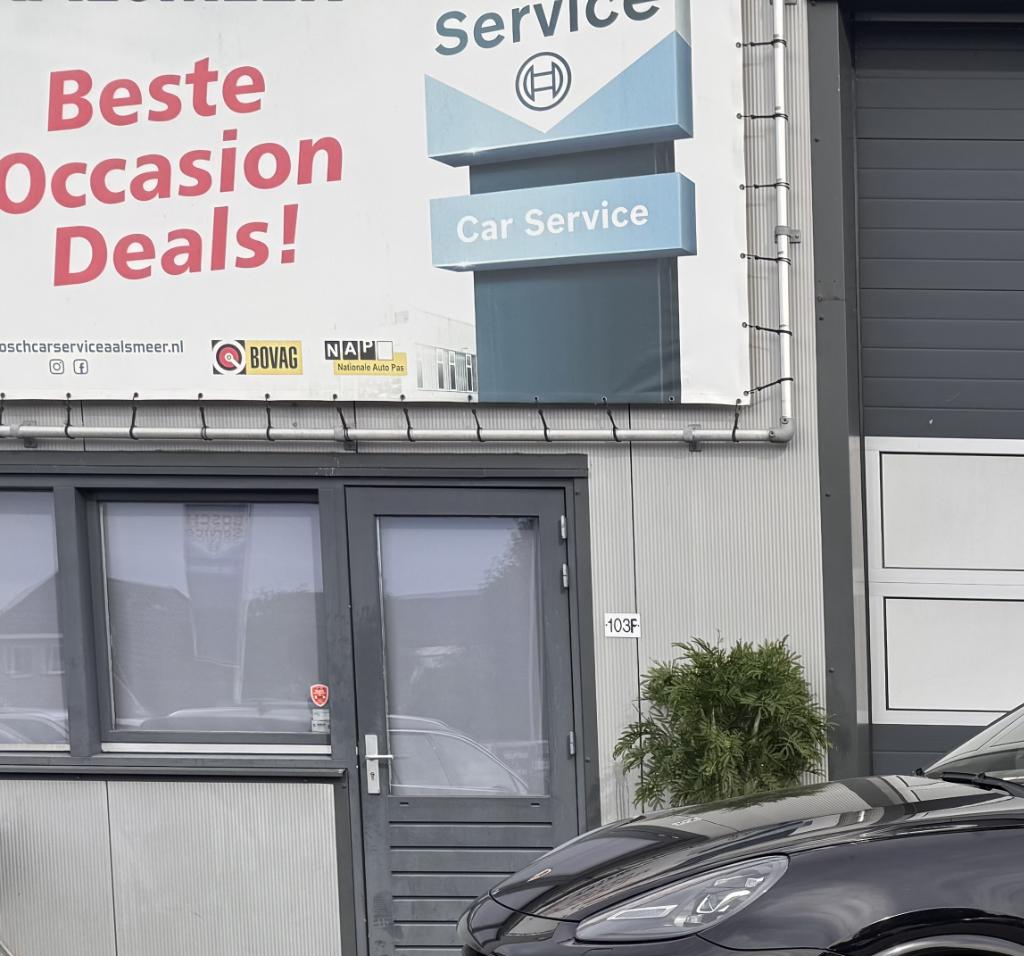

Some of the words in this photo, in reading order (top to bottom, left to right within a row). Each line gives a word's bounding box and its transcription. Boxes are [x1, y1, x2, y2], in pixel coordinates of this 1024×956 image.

[48, 57, 266, 131] Beste
[0, 129, 343, 215] Occasion
[456, 214, 514, 243] Car
[524, 200, 649, 237] Service
[54, 204, 298, 286] Deals!
[250, 346, 298, 369] BOVAG
[325, 341, 376, 358] NAP
[337, 363, 371, 372] Nationale
[372, 363, 389, 372] Auto
[391, 363, 405, 372] Pas
[607, 618, 638, 633] 103F
